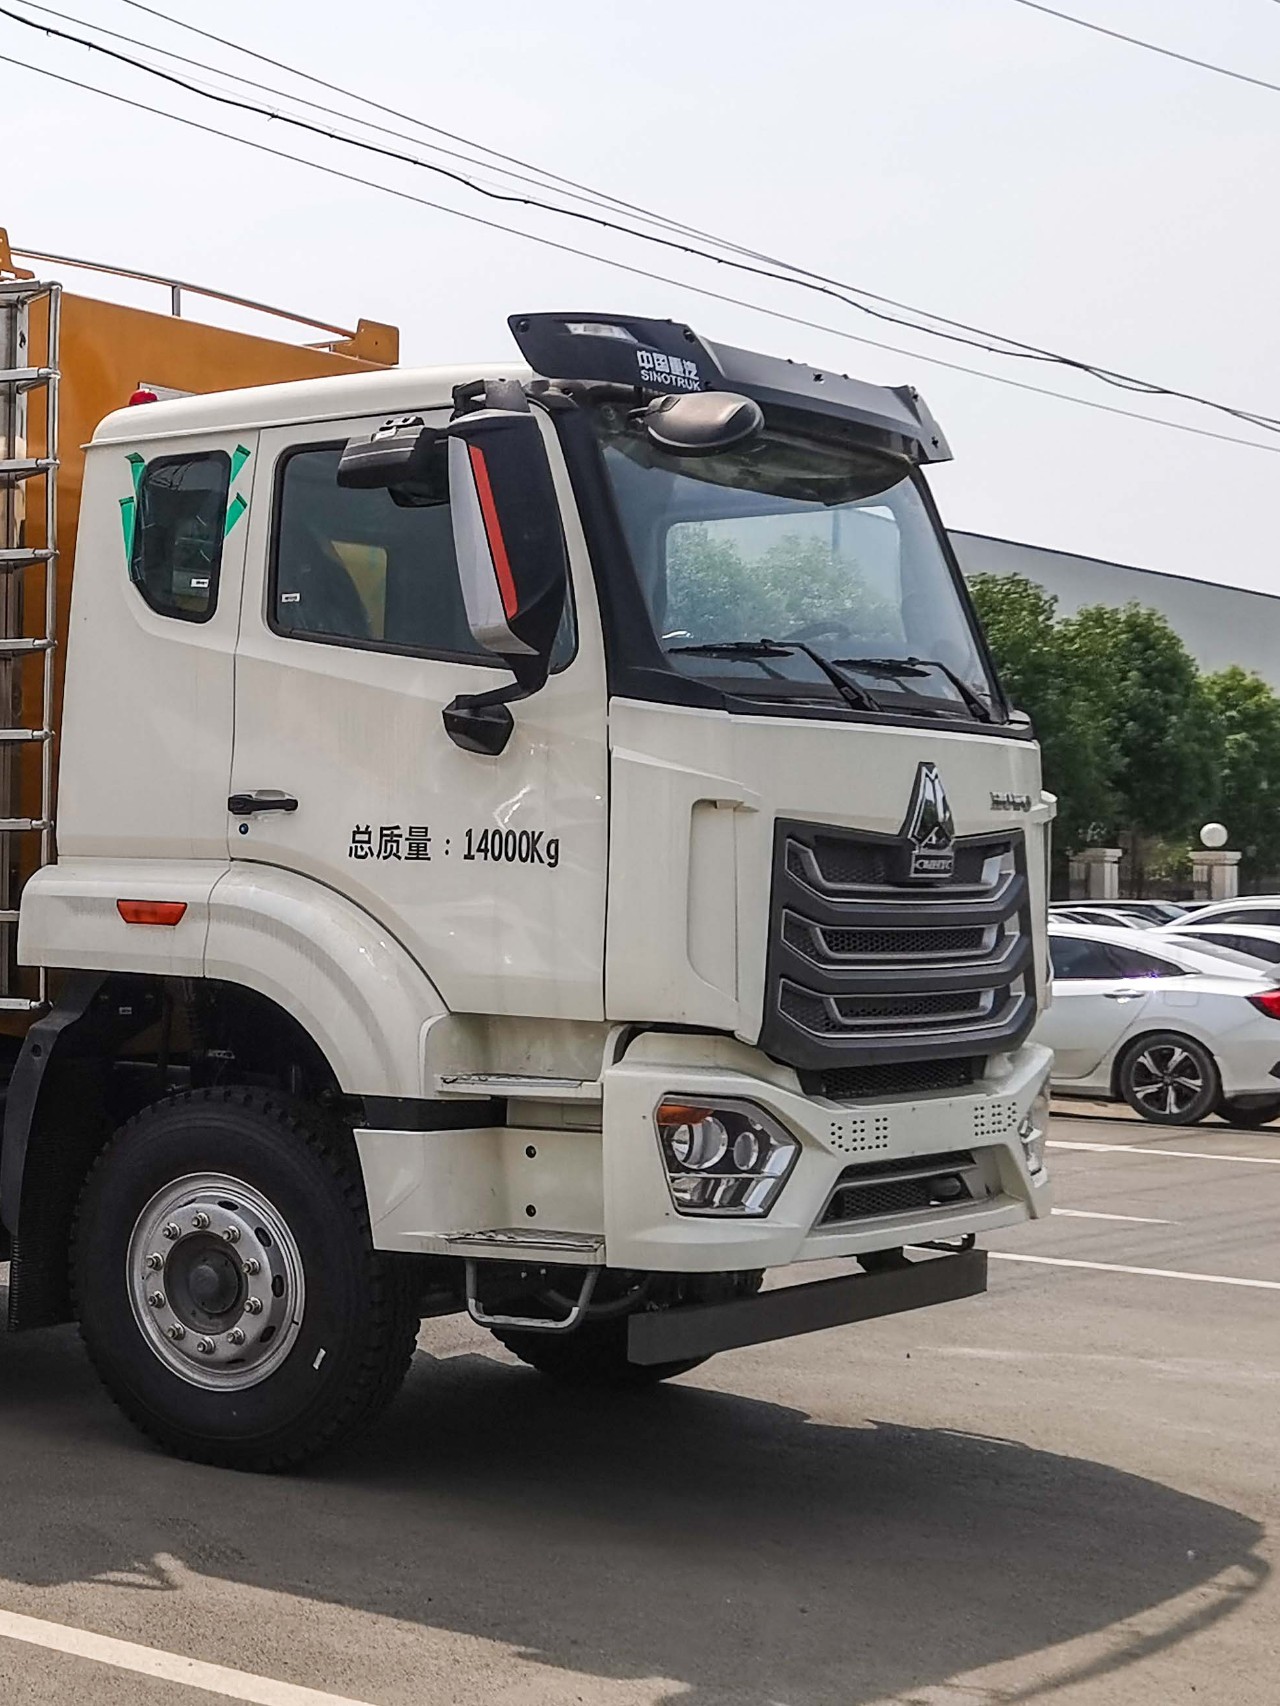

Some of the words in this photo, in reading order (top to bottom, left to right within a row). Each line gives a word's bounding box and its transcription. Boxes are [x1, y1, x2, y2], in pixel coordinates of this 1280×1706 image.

[636, 350, 700, 380] 中国重汽
[641, 369, 702, 391] SINOTRUK
